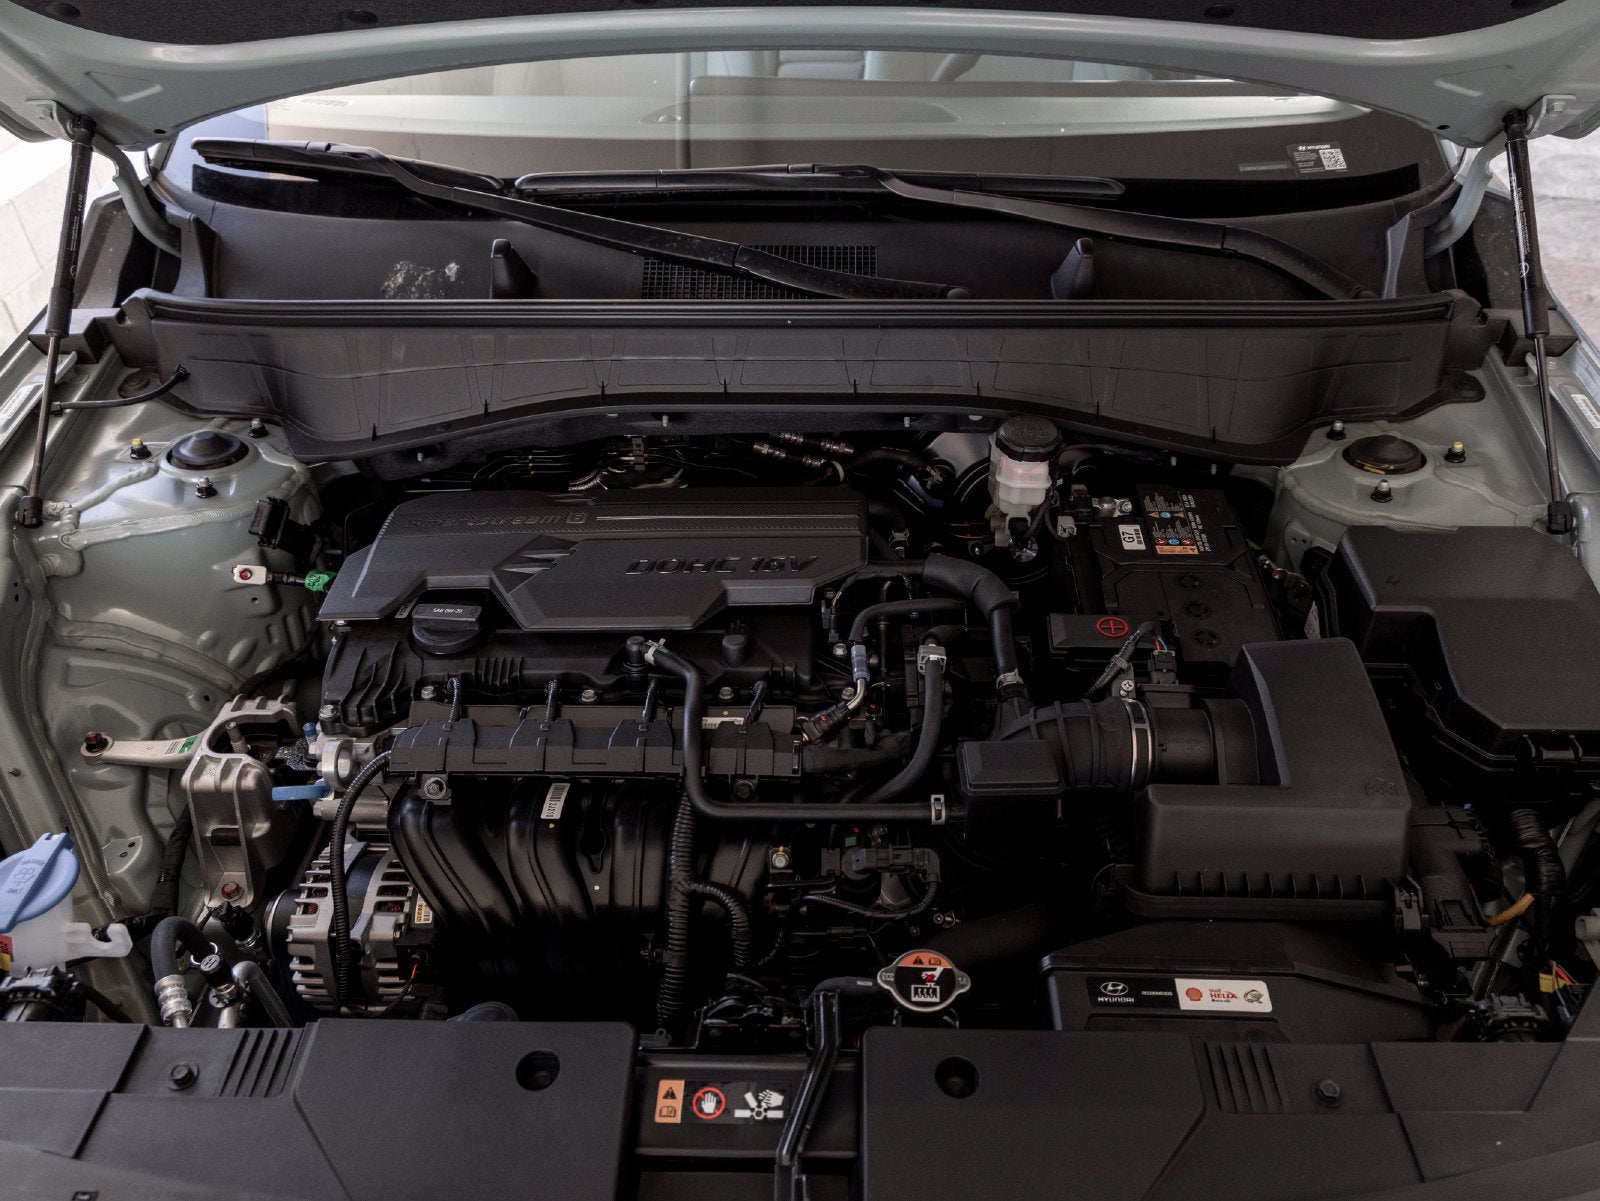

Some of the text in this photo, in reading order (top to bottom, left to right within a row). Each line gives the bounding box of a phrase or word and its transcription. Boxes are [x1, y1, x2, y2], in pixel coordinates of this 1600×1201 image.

[1121, 531, 1135, 543] G7
[625, 555, 819, 575] DOHC 16V
